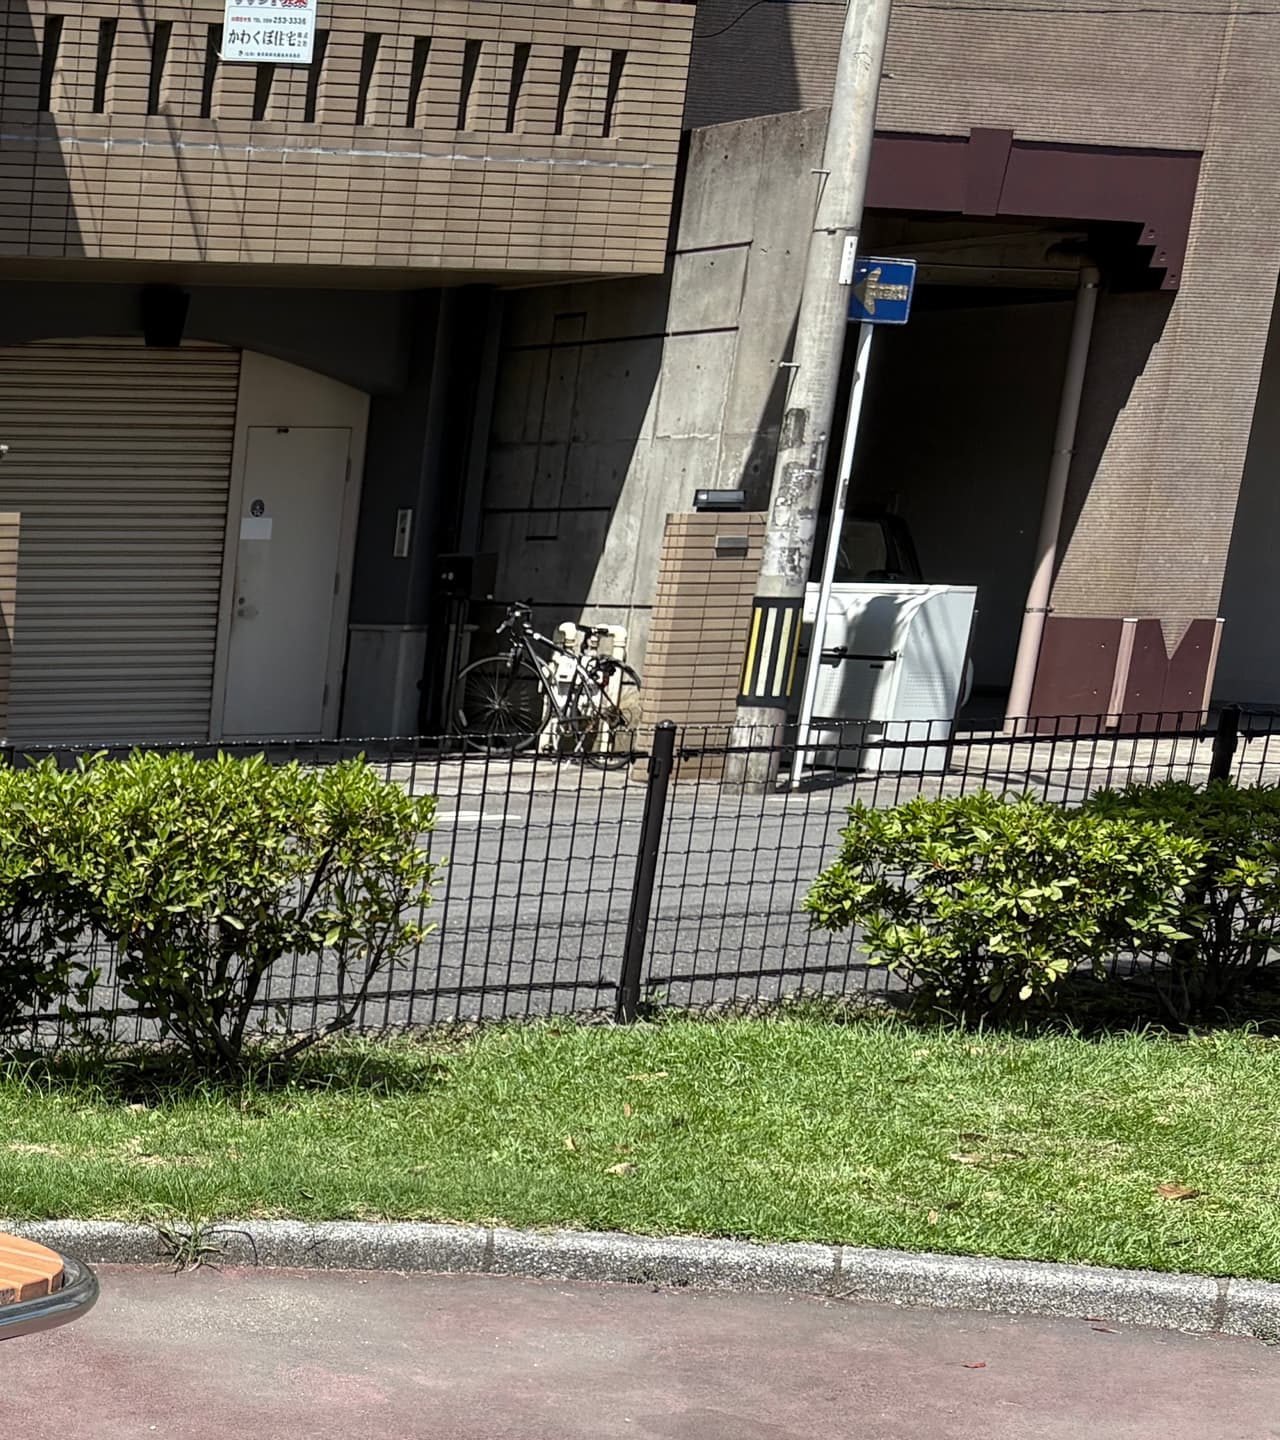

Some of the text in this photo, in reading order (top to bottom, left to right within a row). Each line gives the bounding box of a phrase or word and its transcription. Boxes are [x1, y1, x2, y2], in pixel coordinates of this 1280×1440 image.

[228, 29, 296, 47] かわくぼ住宅
